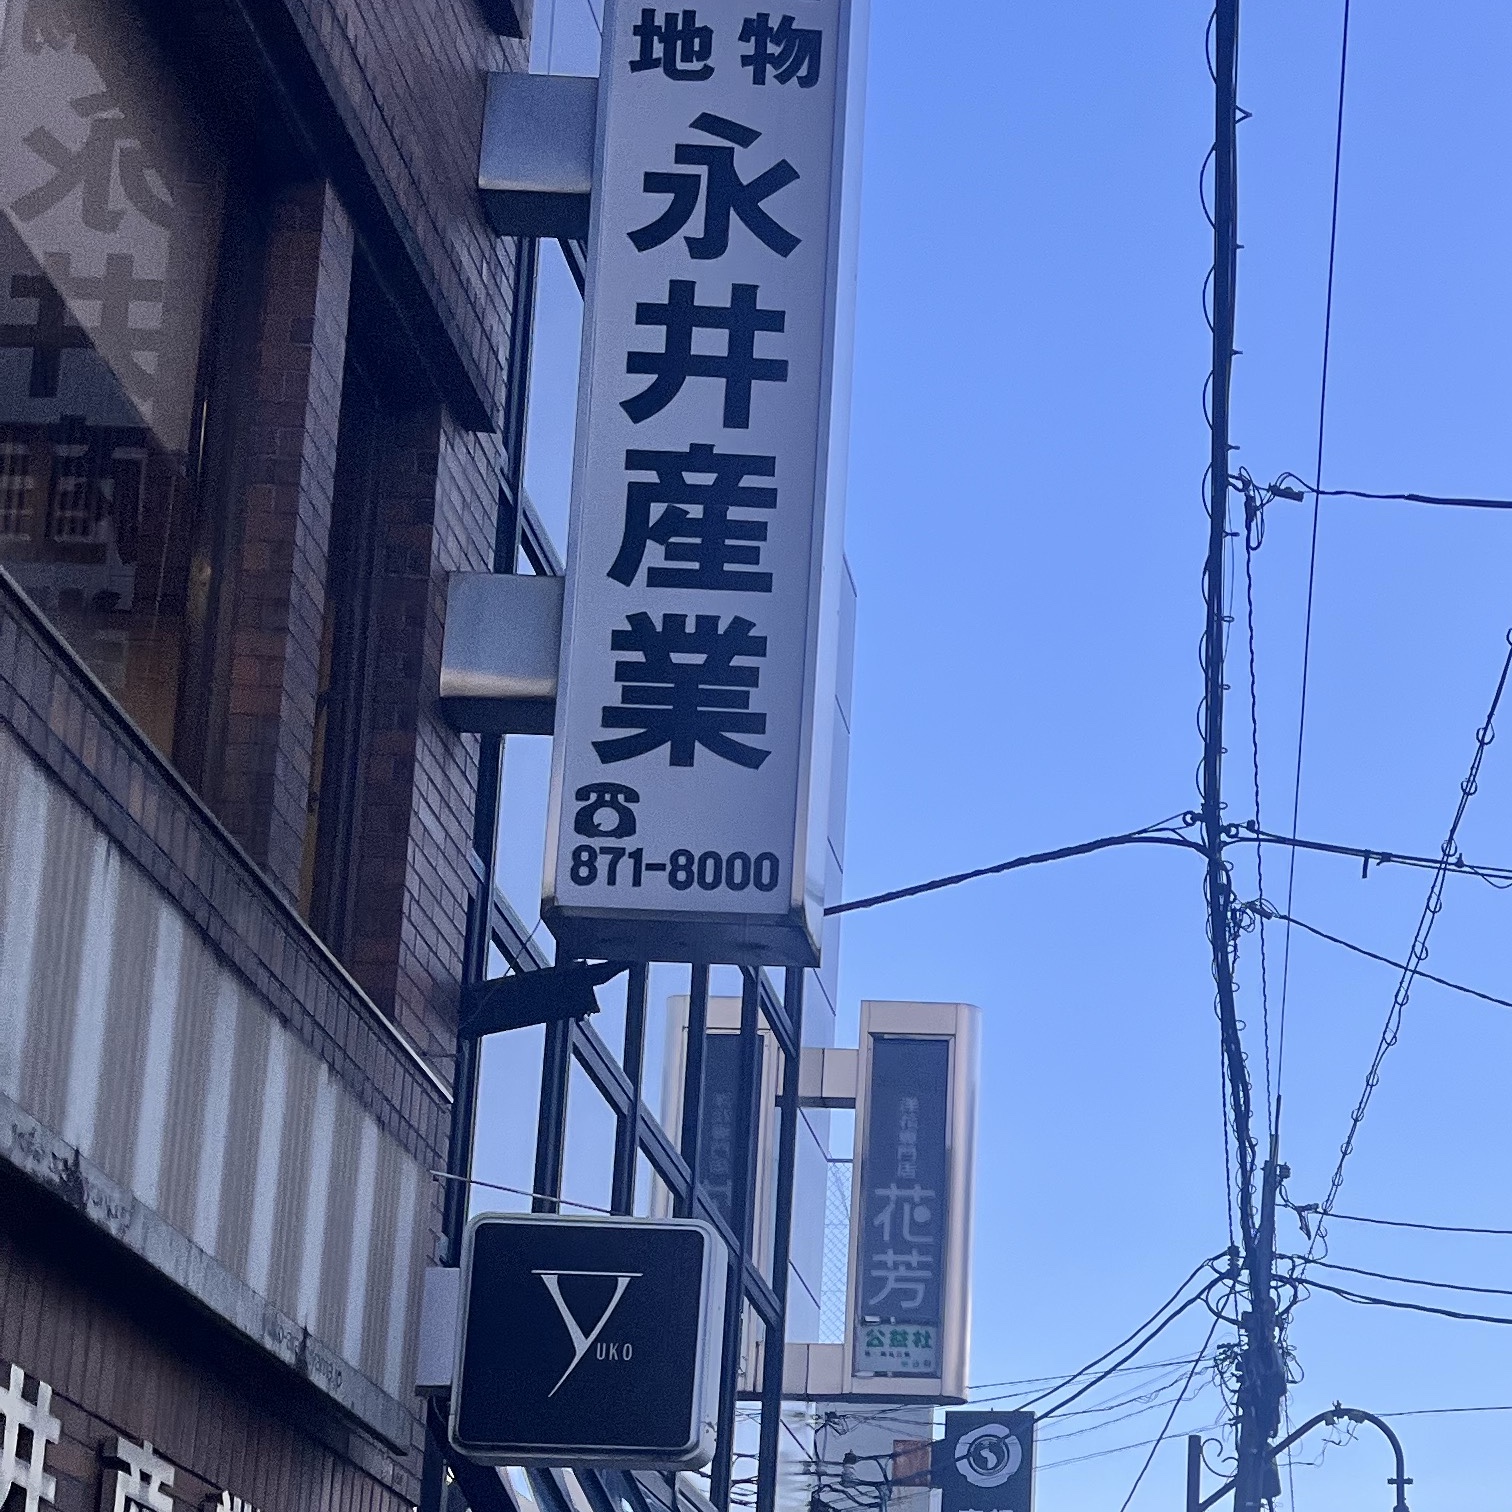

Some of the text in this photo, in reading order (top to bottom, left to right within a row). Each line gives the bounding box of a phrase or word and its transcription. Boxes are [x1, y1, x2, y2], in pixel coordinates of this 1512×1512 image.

[592, 112, 802, 771] 永井産業
[571, 845, 780, 893] 871-8000
[869, 1182, 935, 1310] 花芳
